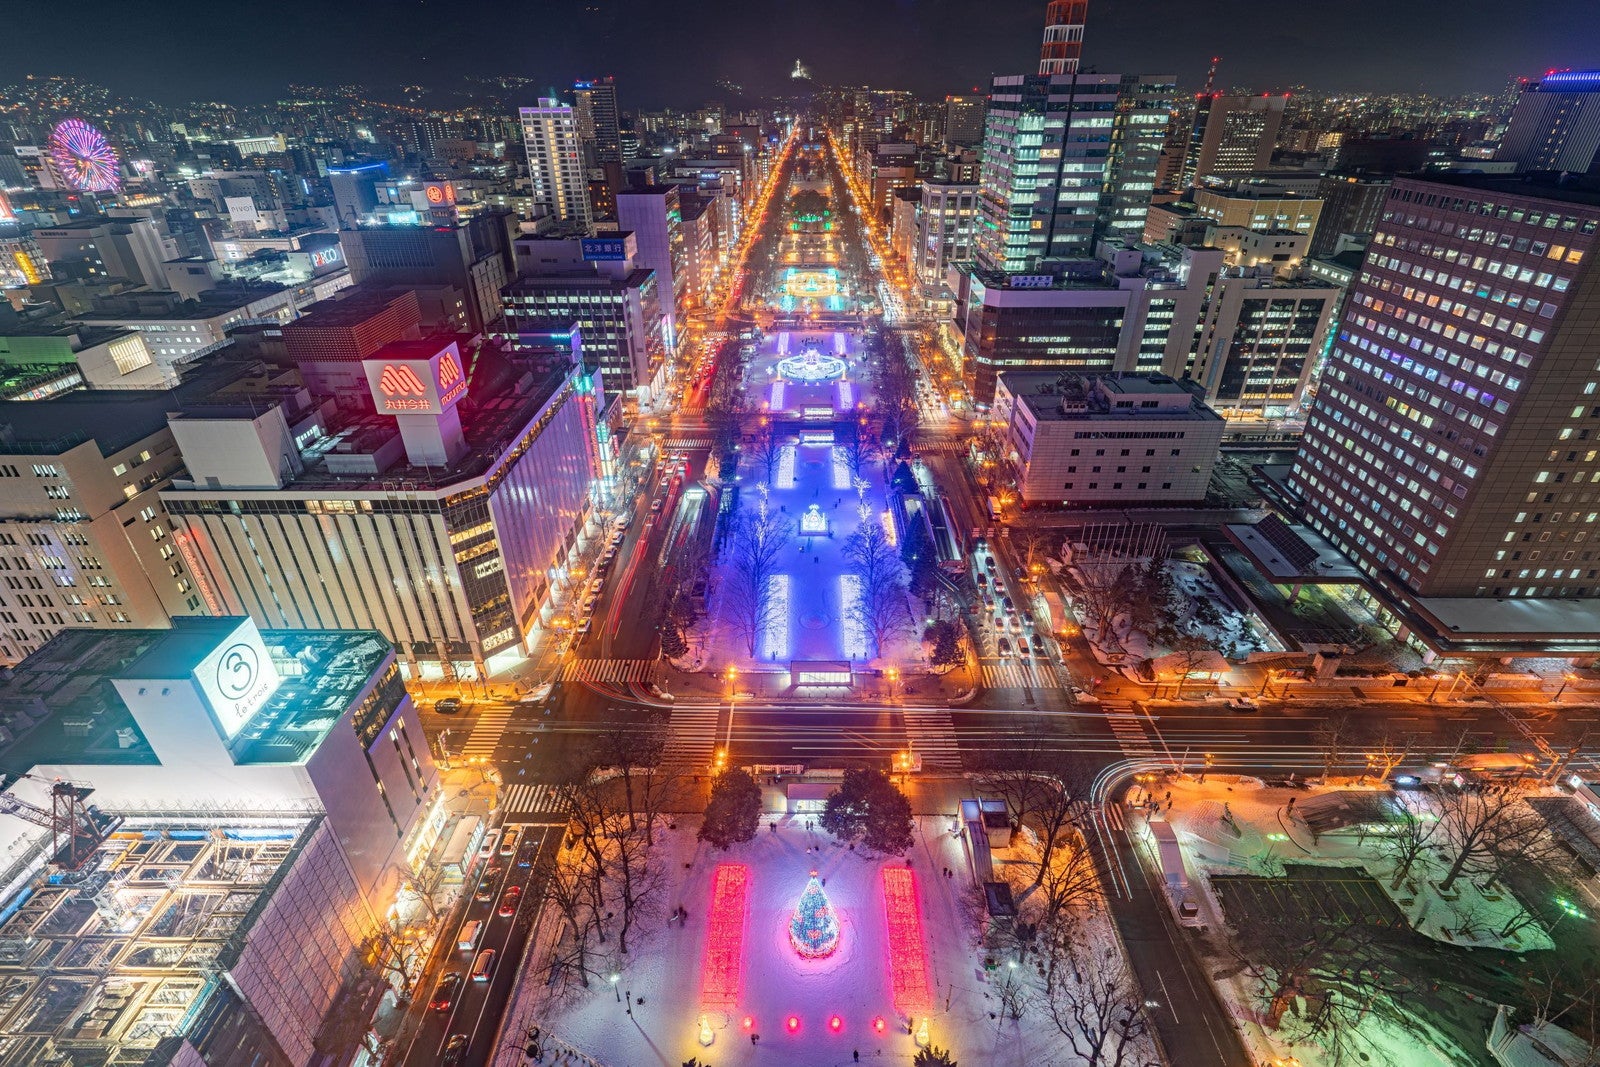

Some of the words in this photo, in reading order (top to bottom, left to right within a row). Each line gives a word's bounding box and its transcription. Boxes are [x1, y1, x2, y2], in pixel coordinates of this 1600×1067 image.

[231, 205, 254, 213] PIVOT
[585, 244, 621, 253] 北洋銀行
[312, 248, 337, 267] PARCO
[385, 399, 431, 410] 丸井今井
[249, 683, 269, 707] trois
